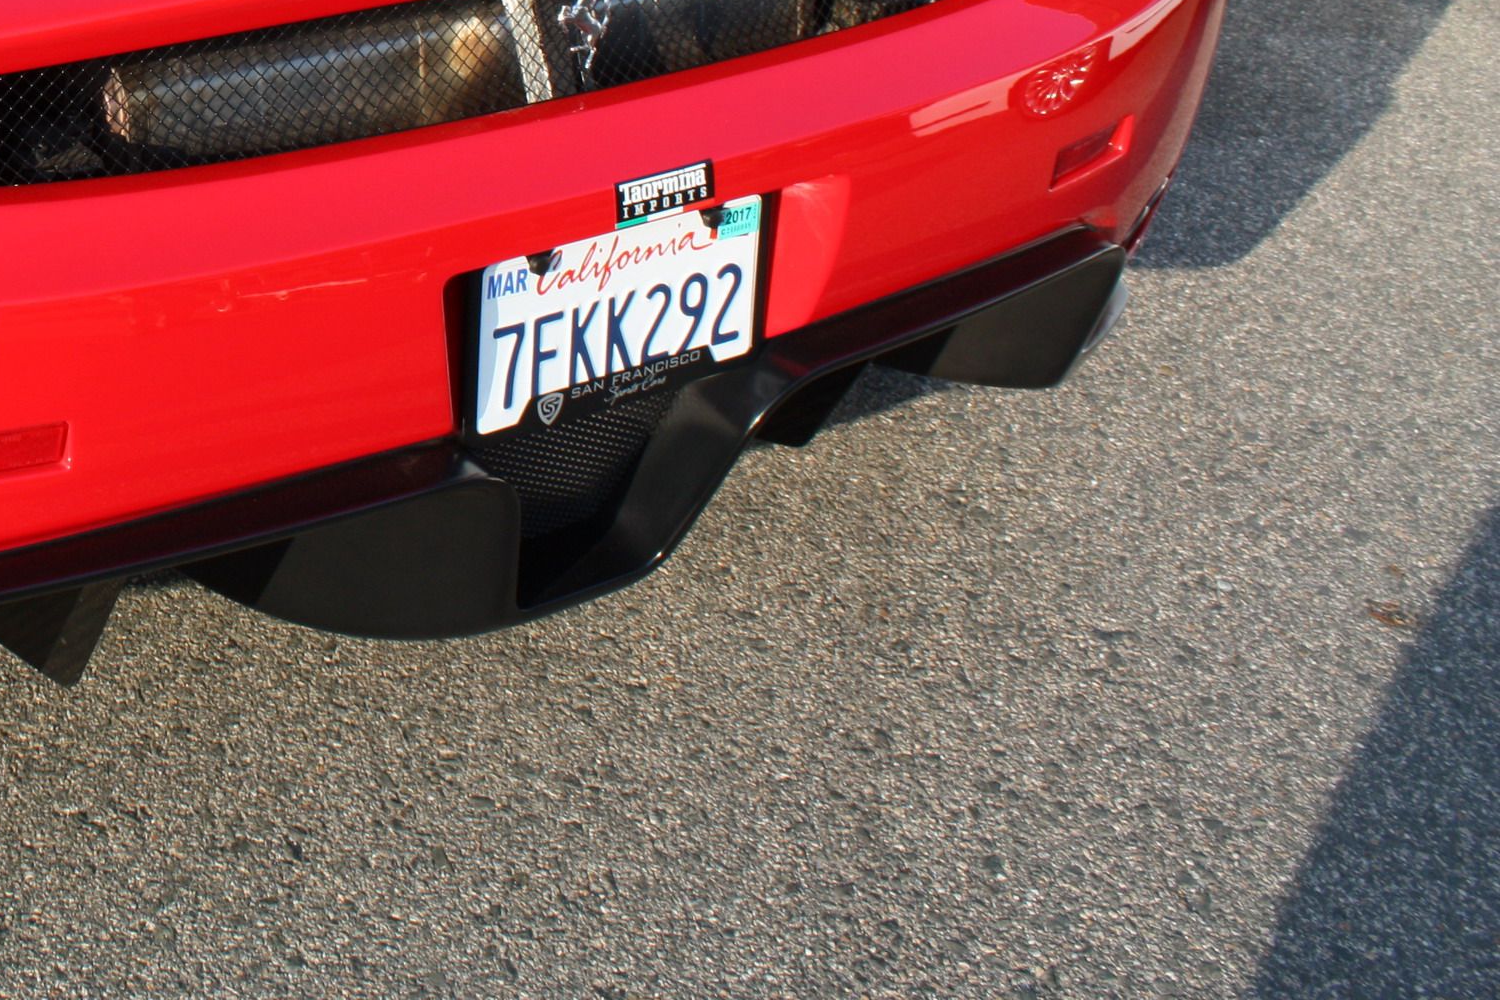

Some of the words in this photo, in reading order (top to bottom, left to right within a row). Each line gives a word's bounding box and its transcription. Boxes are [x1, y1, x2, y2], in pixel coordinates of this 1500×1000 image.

[619, 162, 707, 206] Taormina
[622, 186, 709, 219] IMPORTS
[724, 206, 753, 225] 2017
[536, 223, 713, 296] California
[486, 268, 529, 300] MAR
[493, 263, 743, 411] 7FKK292
[571, 379, 605, 399] SAN
[611, 350, 701, 388] FRANCISCO
